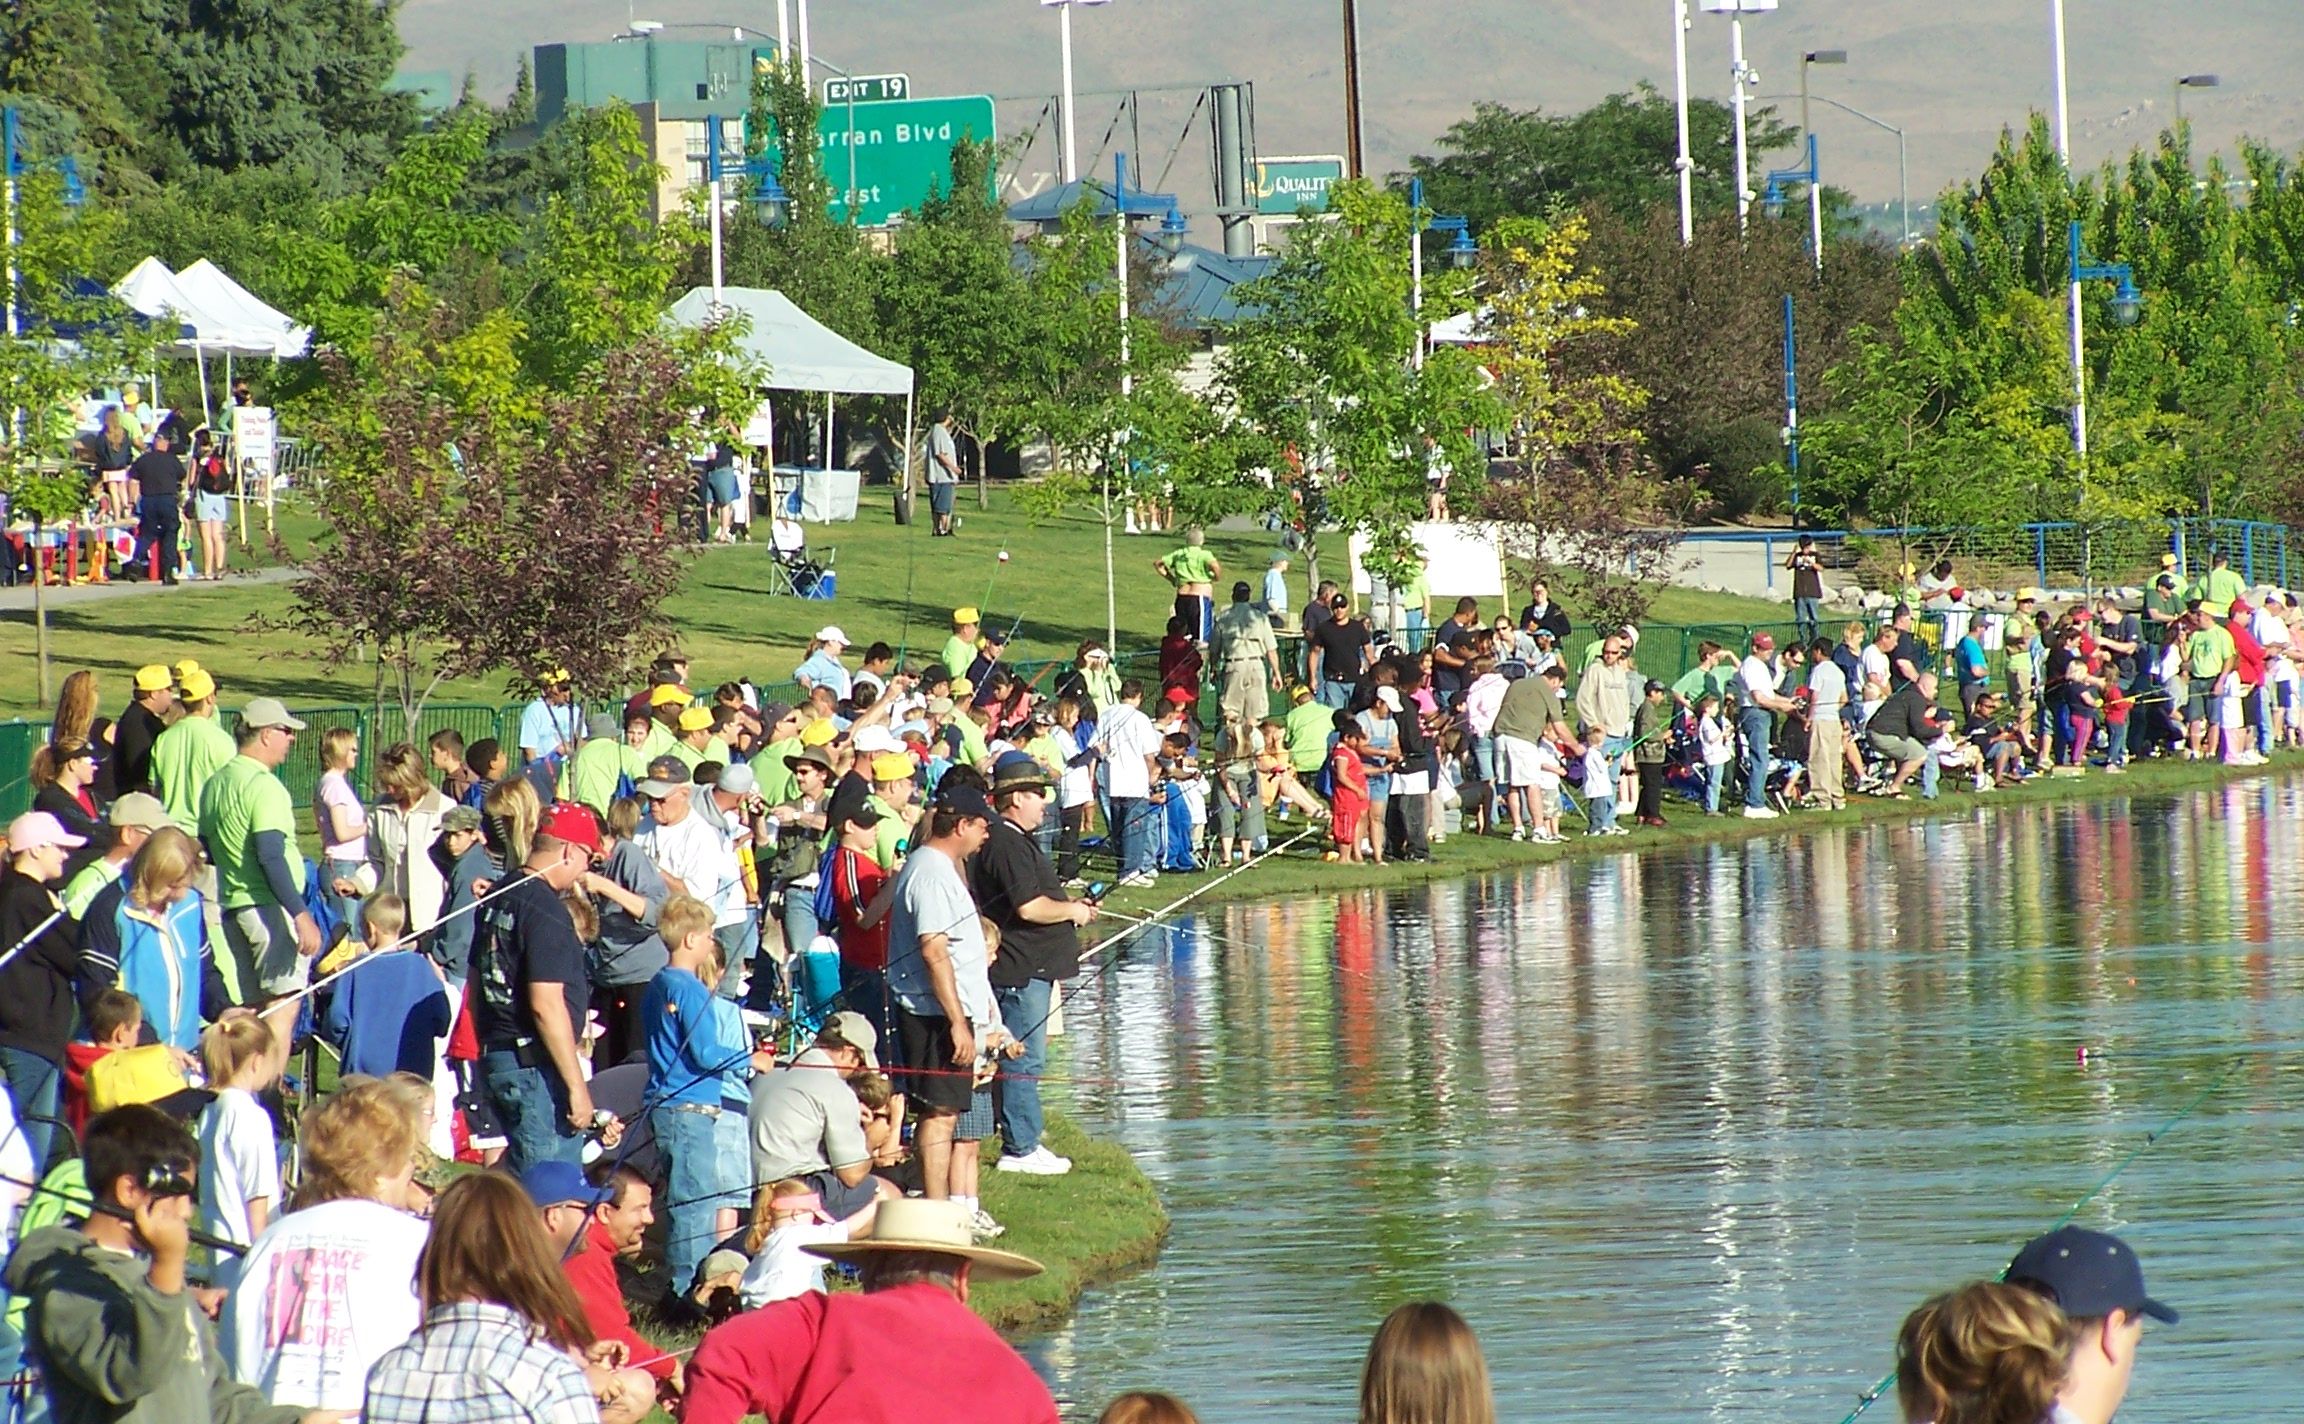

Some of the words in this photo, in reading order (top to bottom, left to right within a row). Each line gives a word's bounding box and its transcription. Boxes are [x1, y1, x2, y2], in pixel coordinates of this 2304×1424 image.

[831, 82, 868, 98] EXIT
[880, 78, 903, 98] 19
[896, 121, 951, 143] Blvd
[1296, 192, 1318, 201] INN
[312, 1248, 367, 1270] RACE
[301, 1325, 352, 1347] CURE
